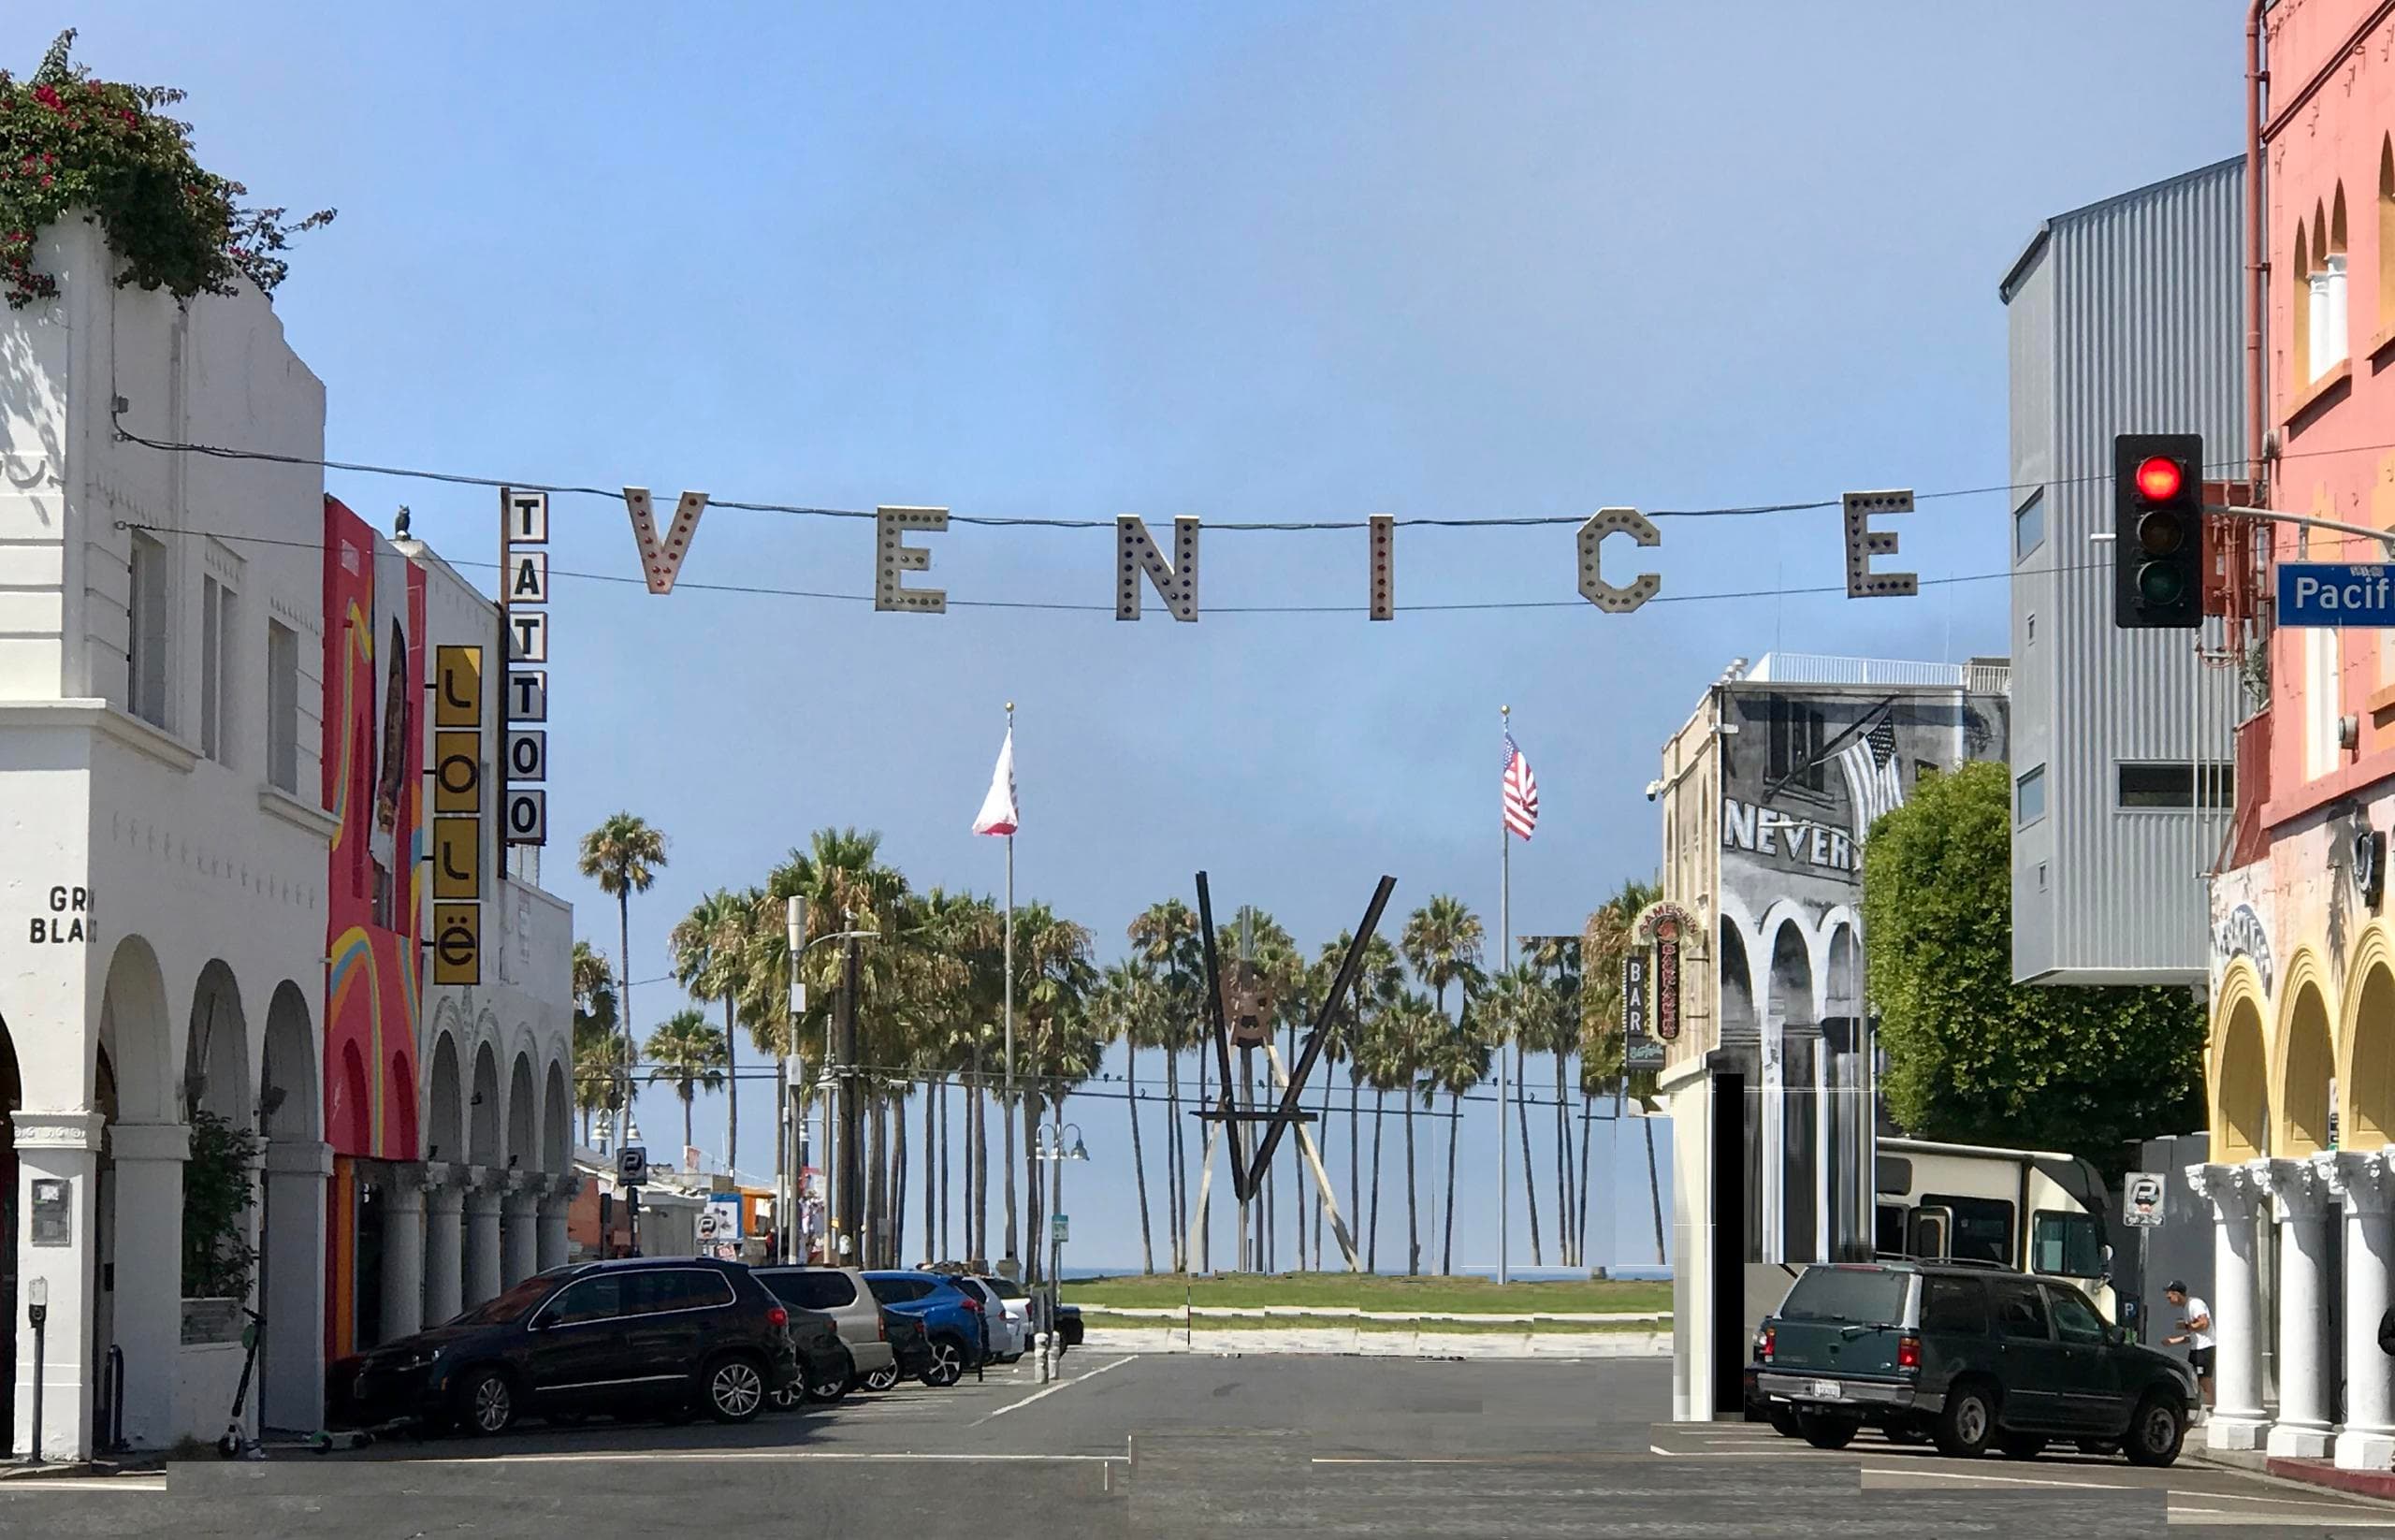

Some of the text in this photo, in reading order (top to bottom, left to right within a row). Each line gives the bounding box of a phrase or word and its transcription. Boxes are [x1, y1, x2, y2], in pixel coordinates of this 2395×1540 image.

[622, 487, 1918, 621] VENICE
[2296, 576, 2395, 609] Pacif
[511, 499, 540, 835] TATTOO
[1723, 797, 1851, 870] NEVER
[1630, 962, 1642, 1031] BAR
